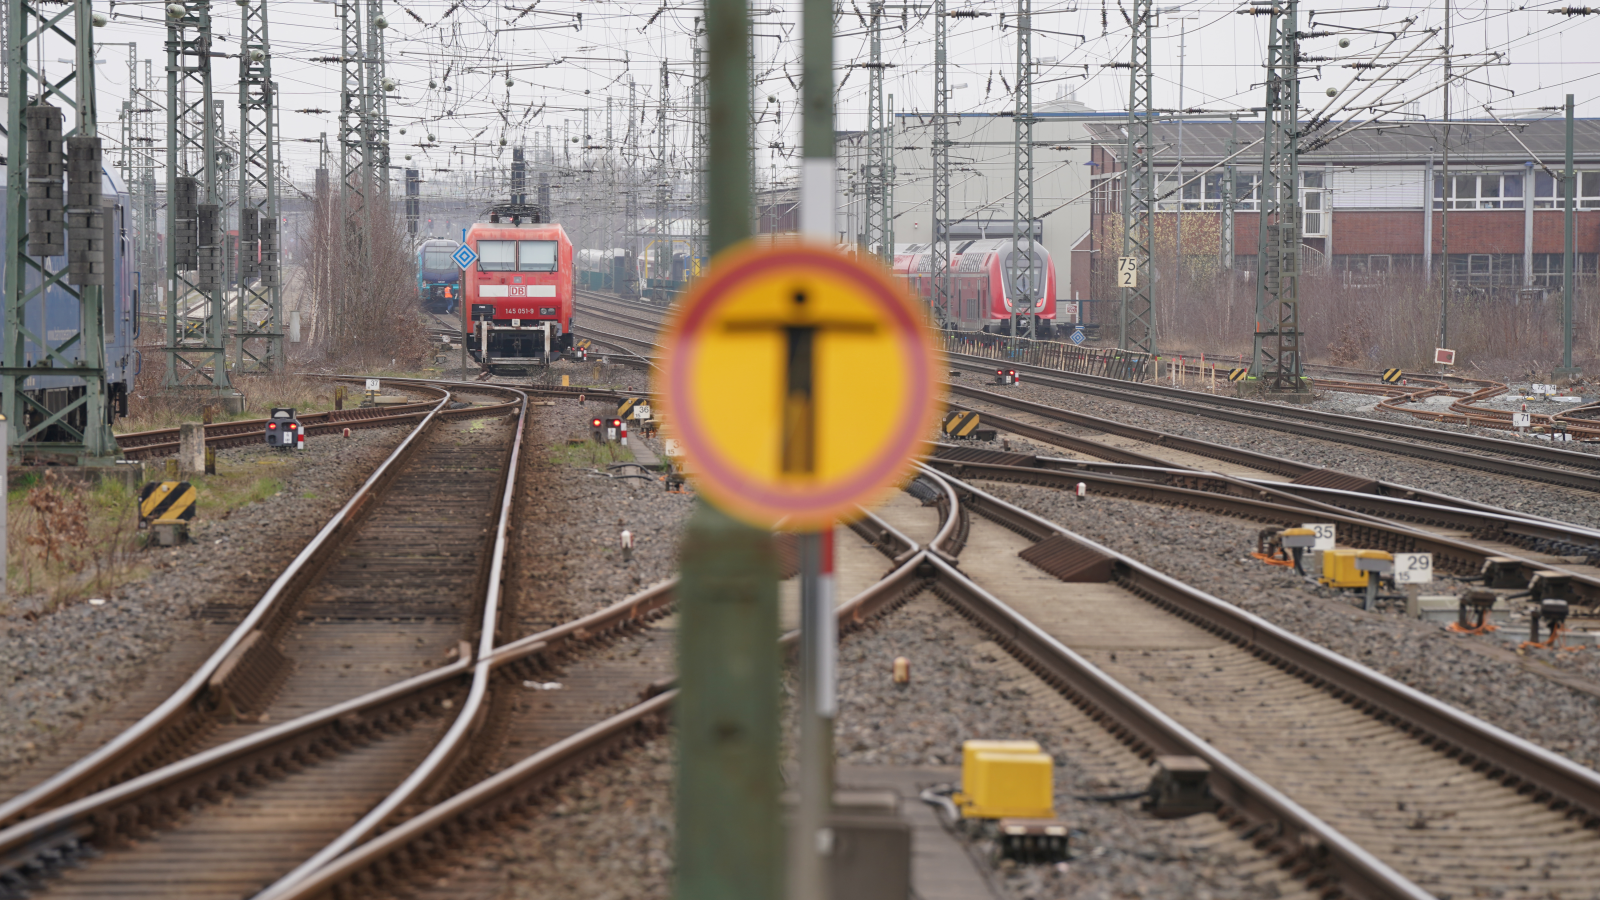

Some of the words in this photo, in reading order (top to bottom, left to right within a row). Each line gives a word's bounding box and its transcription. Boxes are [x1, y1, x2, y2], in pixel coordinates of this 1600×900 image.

[1119, 258, 1136, 271] 75
[1123, 272, 1132, 285] 2
[511, 287, 525, 295] DB
[639, 406, 650, 414] 36
[1520, 413, 1529, 422] 71
[1313, 525, 1333, 539] 35
[1407, 555, 1430, 571] 29
[1398, 571, 1411, 581] 15
